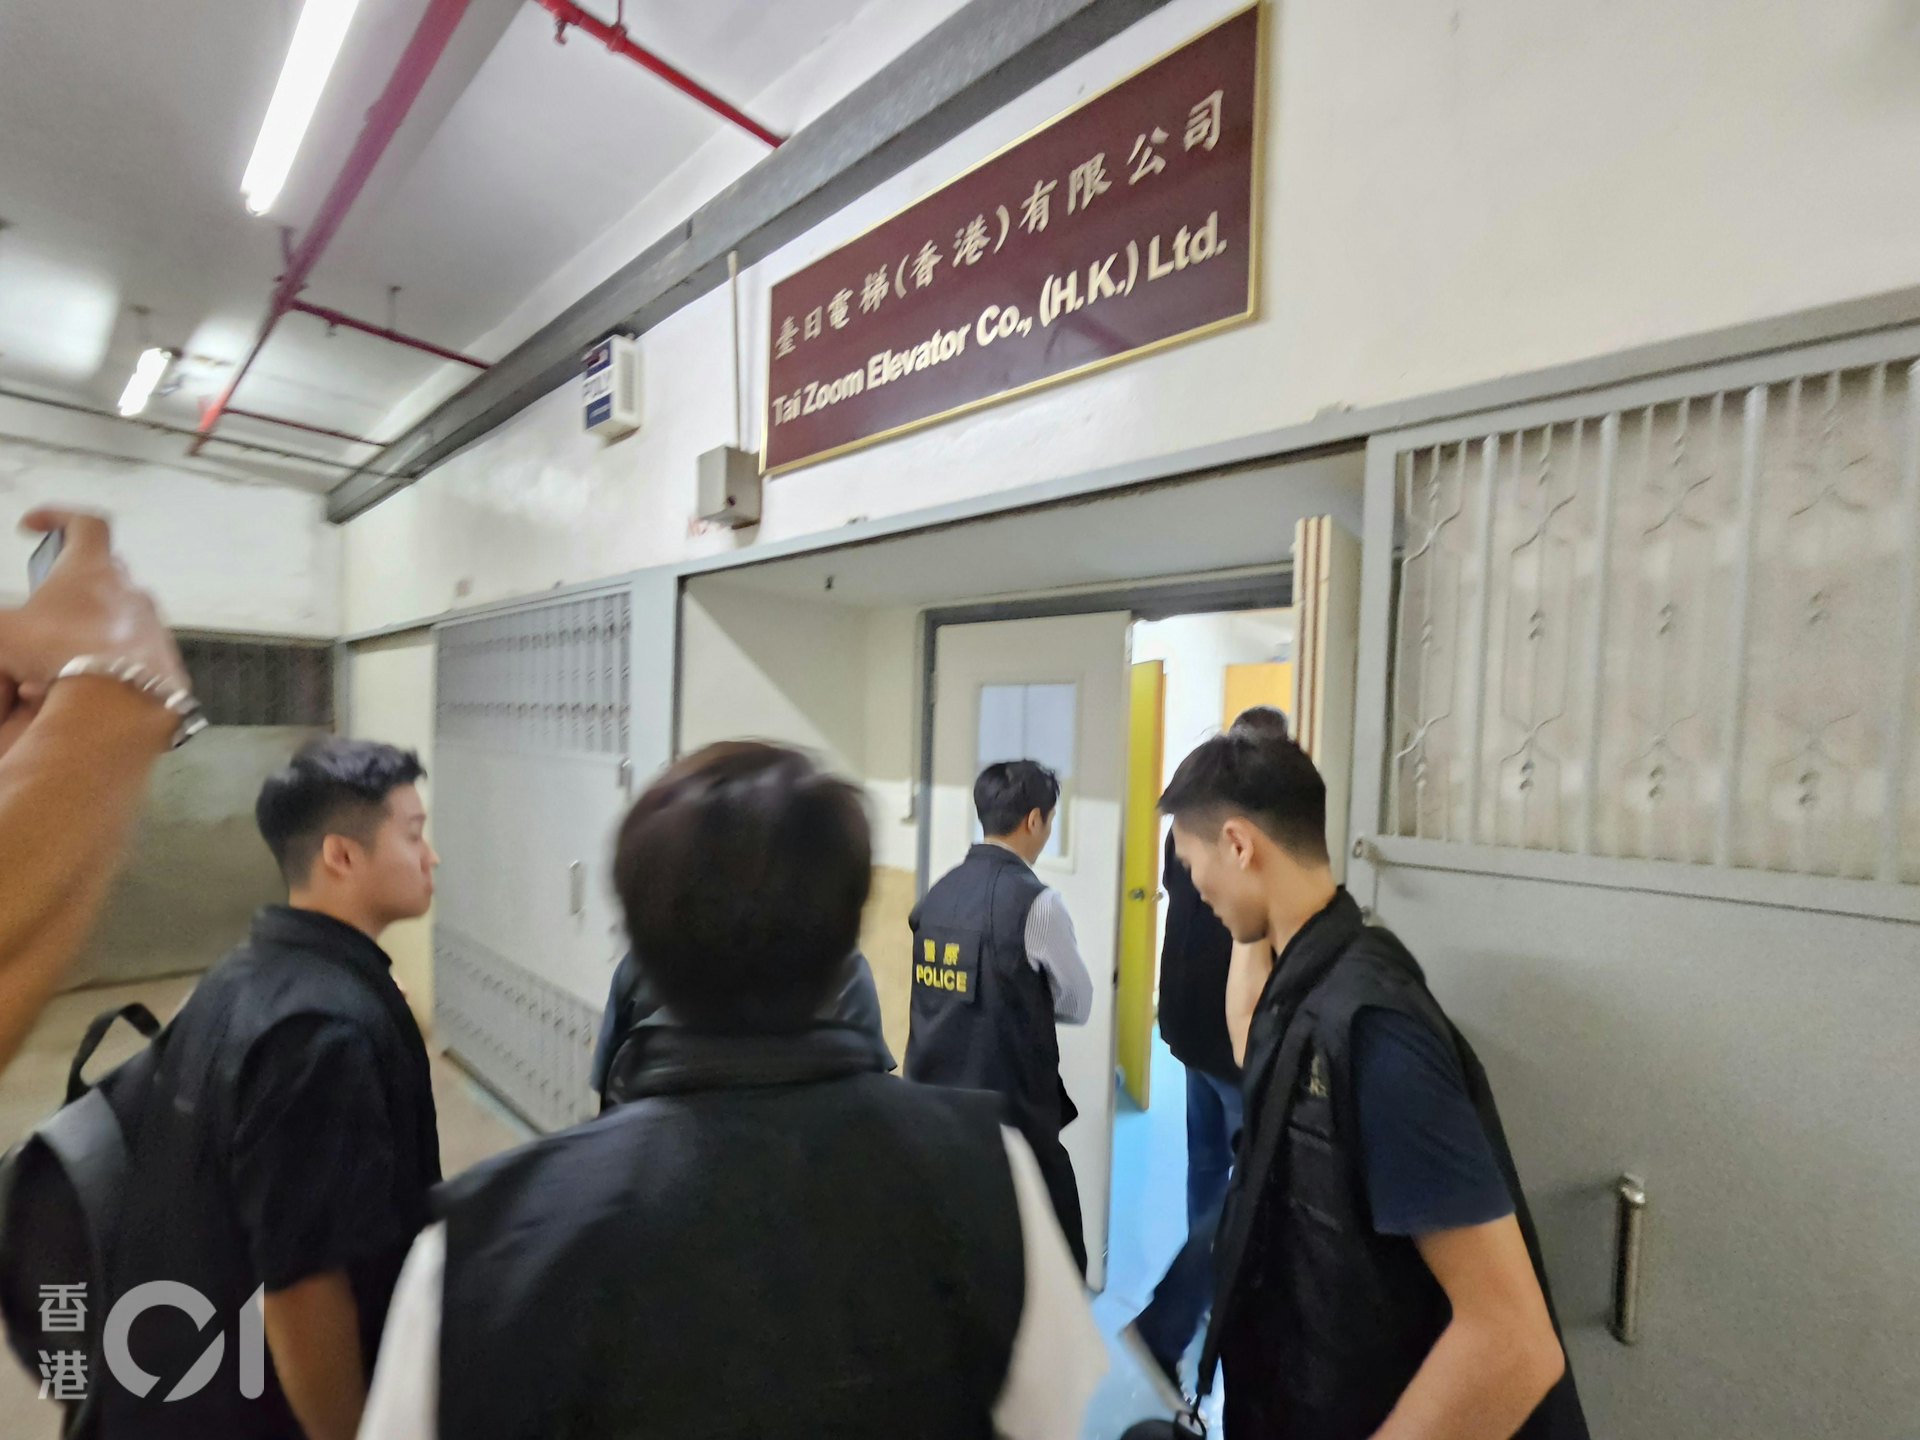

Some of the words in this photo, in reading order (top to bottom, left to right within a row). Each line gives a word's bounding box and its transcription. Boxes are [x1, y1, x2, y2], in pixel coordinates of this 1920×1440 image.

[772, 388, 802, 427] Tai
[802, 367, 865, 416] Zoom
[866, 323, 971, 390] Elevator
[976, 304, 1033, 347] Co.,
[1039, 239, 1139, 328] (H.K.)
[1147, 210, 1228, 282] Ltd.
[916, 963, 967, 993] POLICE
